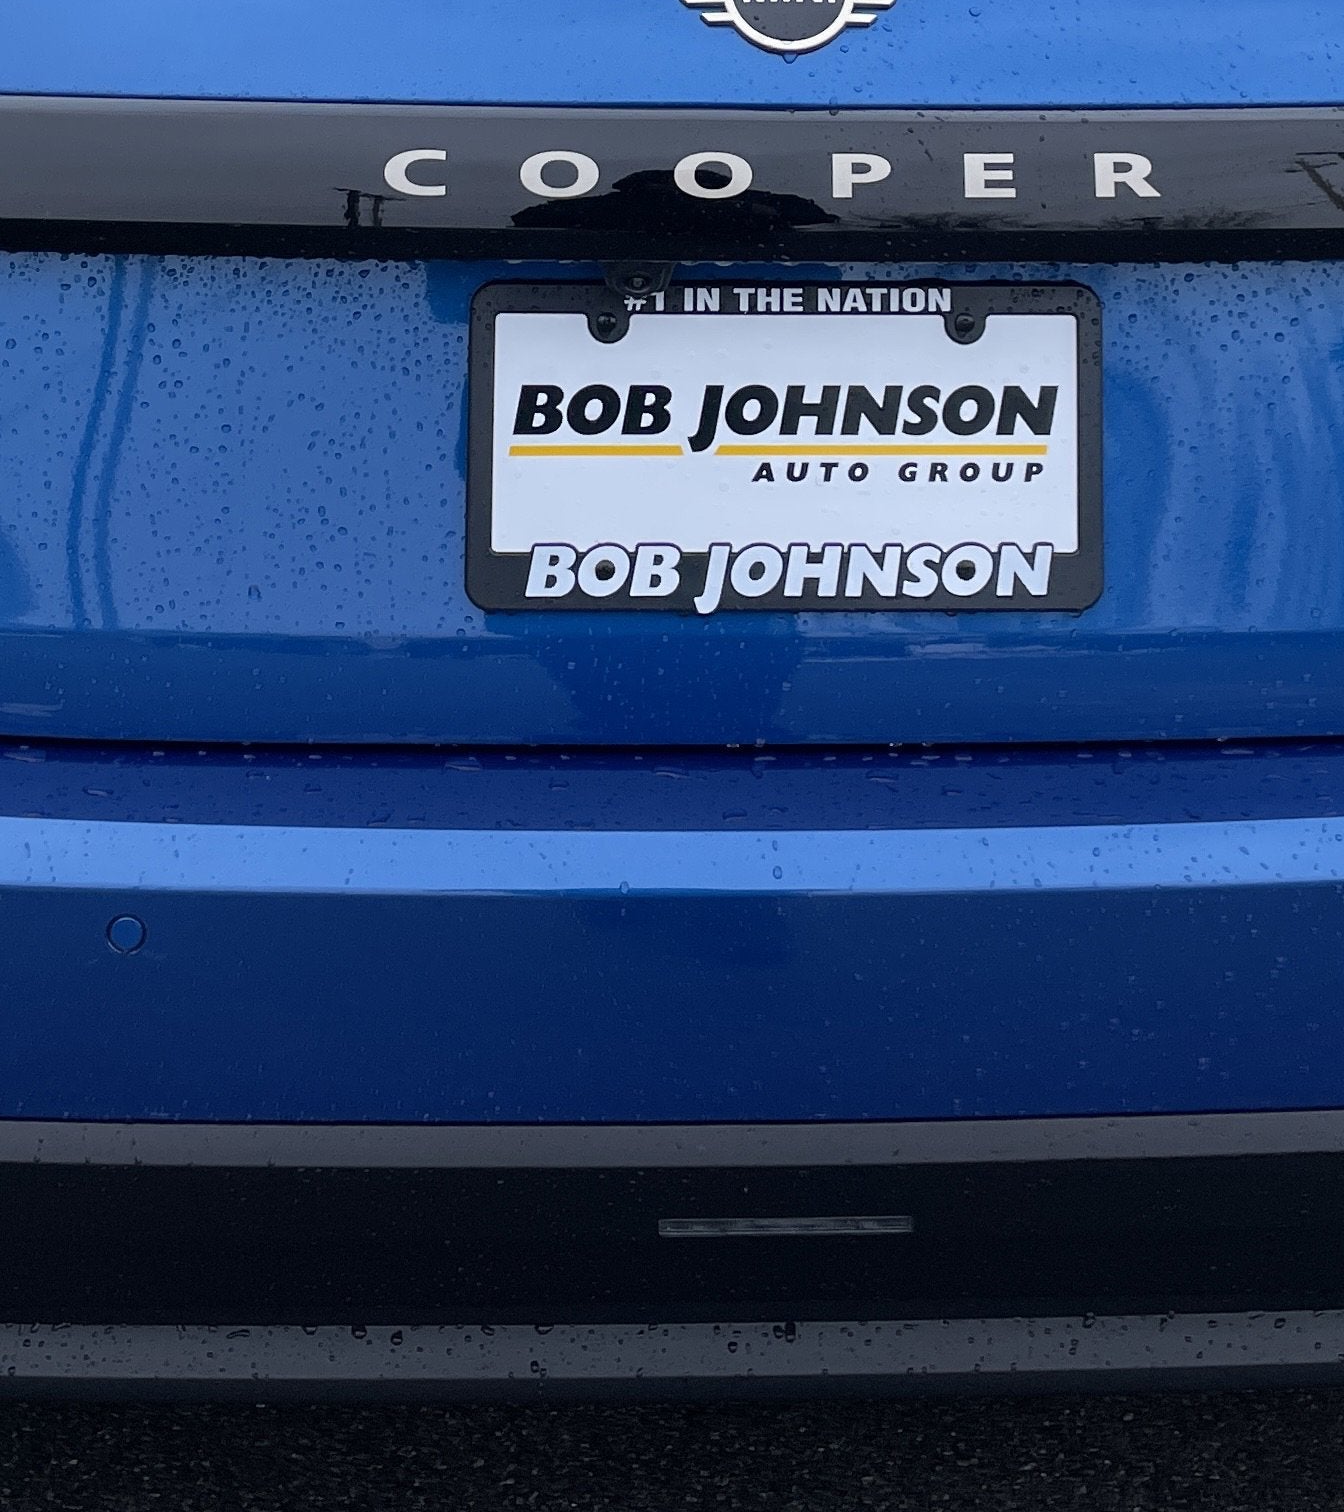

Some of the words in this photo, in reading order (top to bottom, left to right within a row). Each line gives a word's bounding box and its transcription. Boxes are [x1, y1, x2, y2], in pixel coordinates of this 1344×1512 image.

[382, 148, 1162, 199] COOPER
[624, 290, 665, 312] #1
[683, 287, 721, 312] IN
[733, 287, 804, 312] THE
[817, 287, 952, 313] NATION
[512, 384, 673, 436] BOB
[687, 384, 1060, 451] JOHNSON
[751, 461, 871, 483] AUTO
[897, 462, 1045, 483] GROUP
[524, 543, 683, 598] BOB
[694, 542, 1054, 615] JOHNSON
